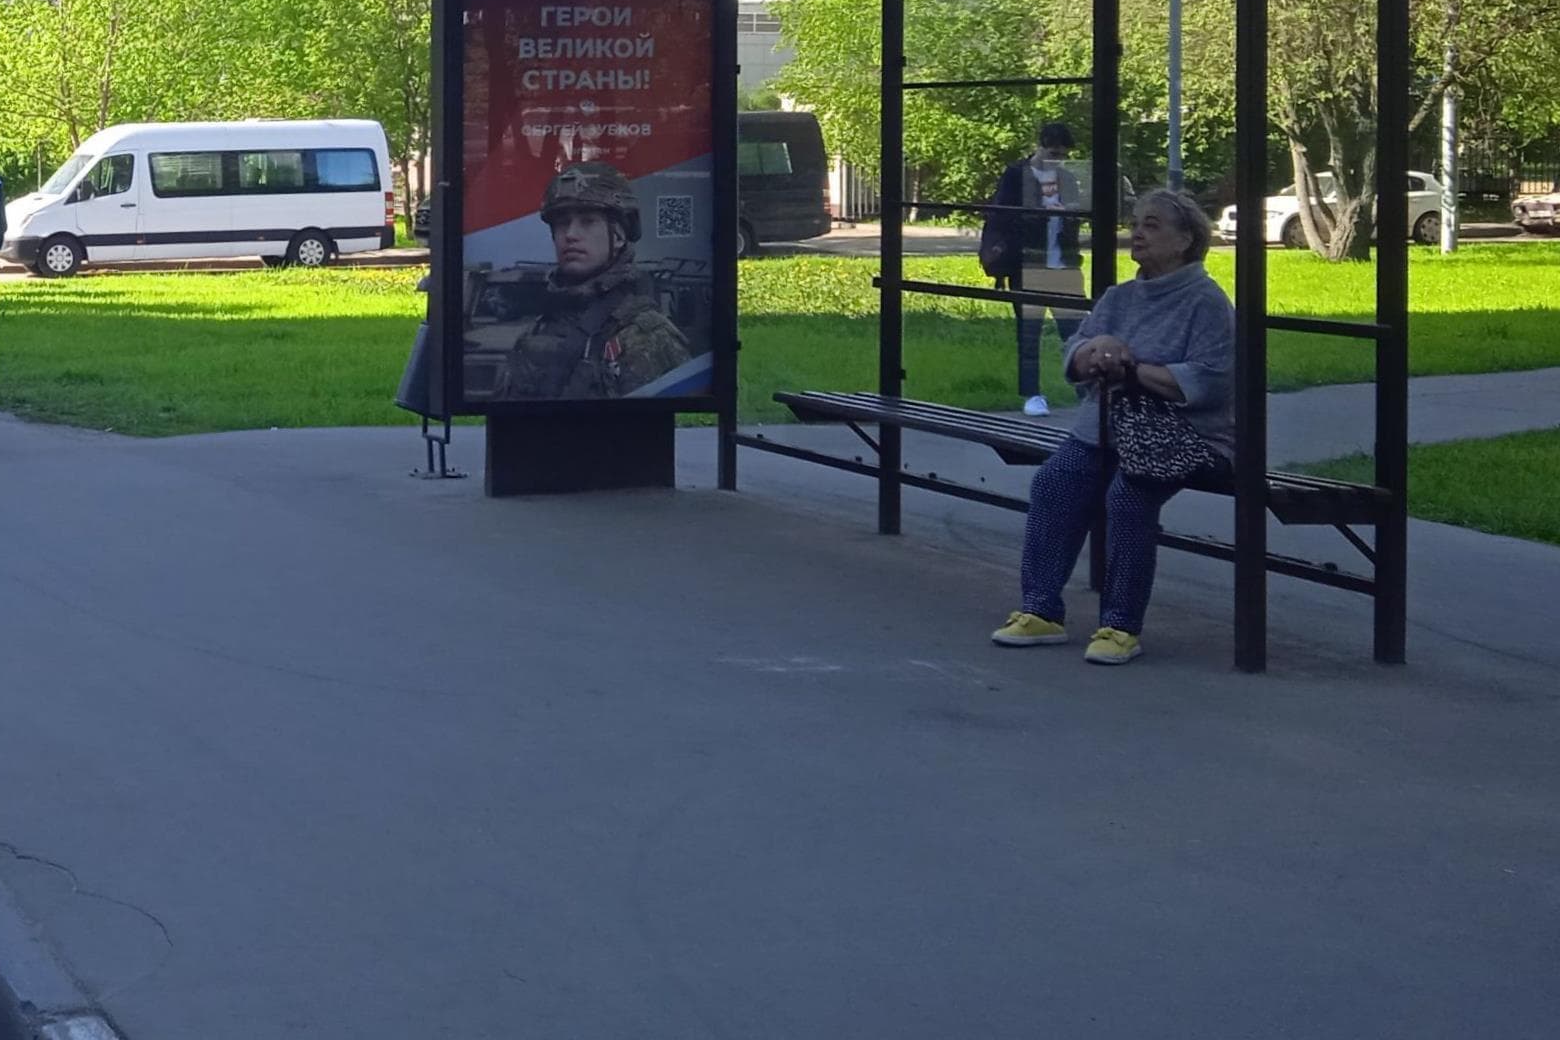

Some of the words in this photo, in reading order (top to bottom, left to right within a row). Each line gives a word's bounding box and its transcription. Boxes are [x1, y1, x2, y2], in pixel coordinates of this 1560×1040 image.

[540, 6, 632, 27] ГЕРОИ
[518, 32, 654, 59] ВЕЛИКОЙ
[522, 69, 651, 90] СТРАНЫ!
[521, 121, 583, 137] СЕРГЕЙ
